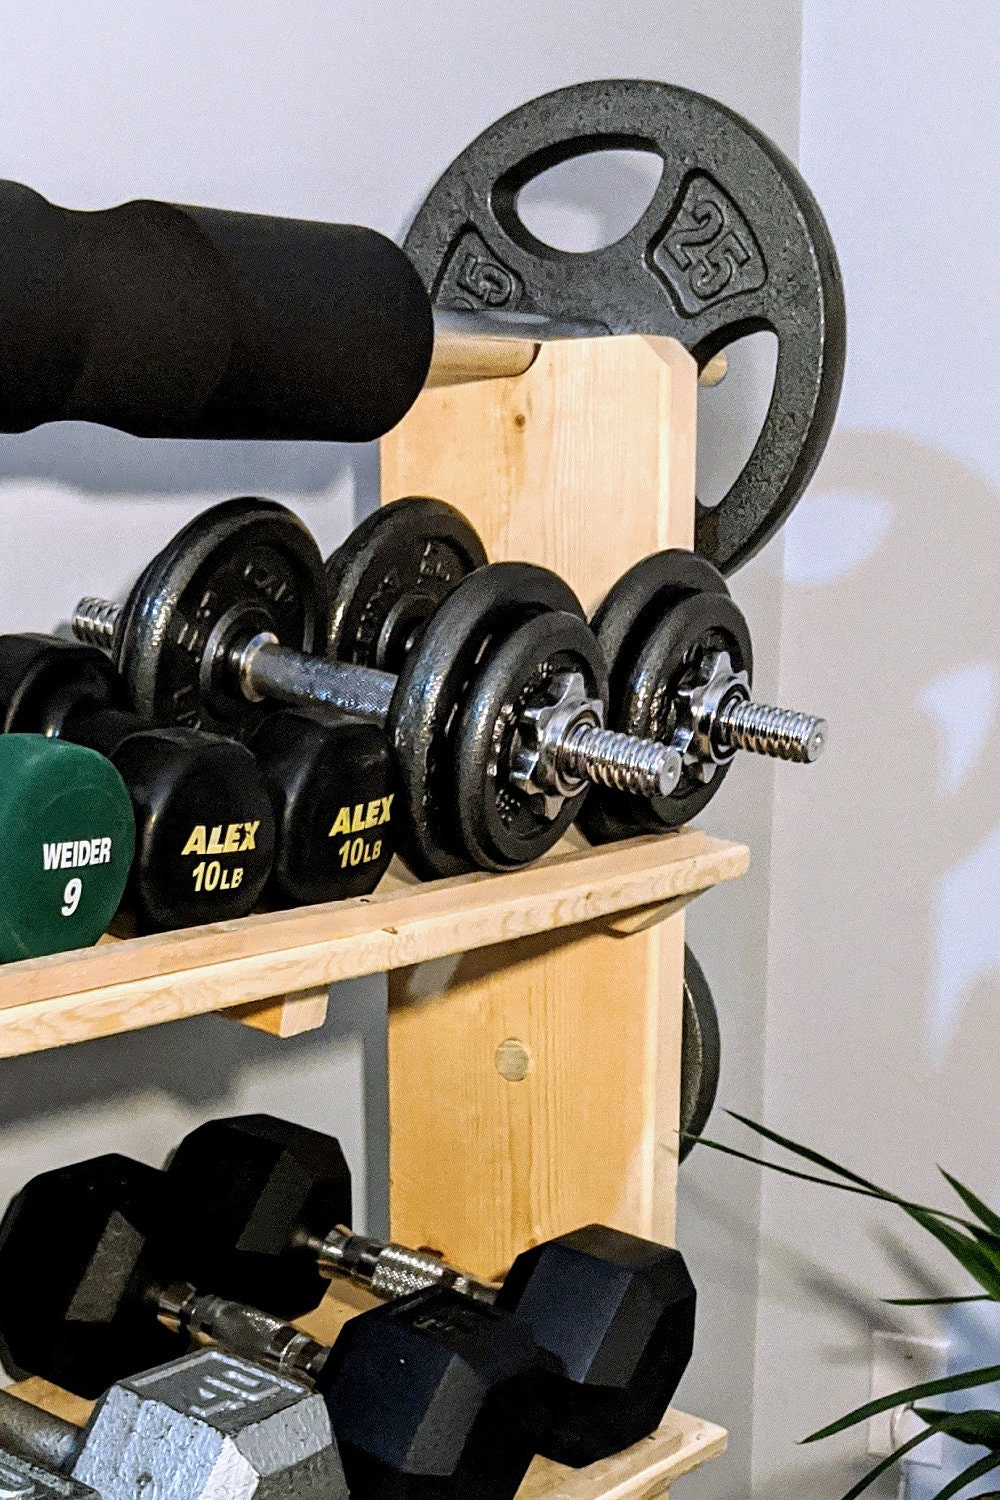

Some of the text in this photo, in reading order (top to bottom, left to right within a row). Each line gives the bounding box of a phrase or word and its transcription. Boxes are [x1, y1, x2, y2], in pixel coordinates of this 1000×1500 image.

[662, 199, 752, 300] 25
[328, 793, 395, 837] ALEX
[42, 837, 112, 870] WEIDER
[181, 820, 261, 856] ALEX
[61, 878, 83, 917] 9
